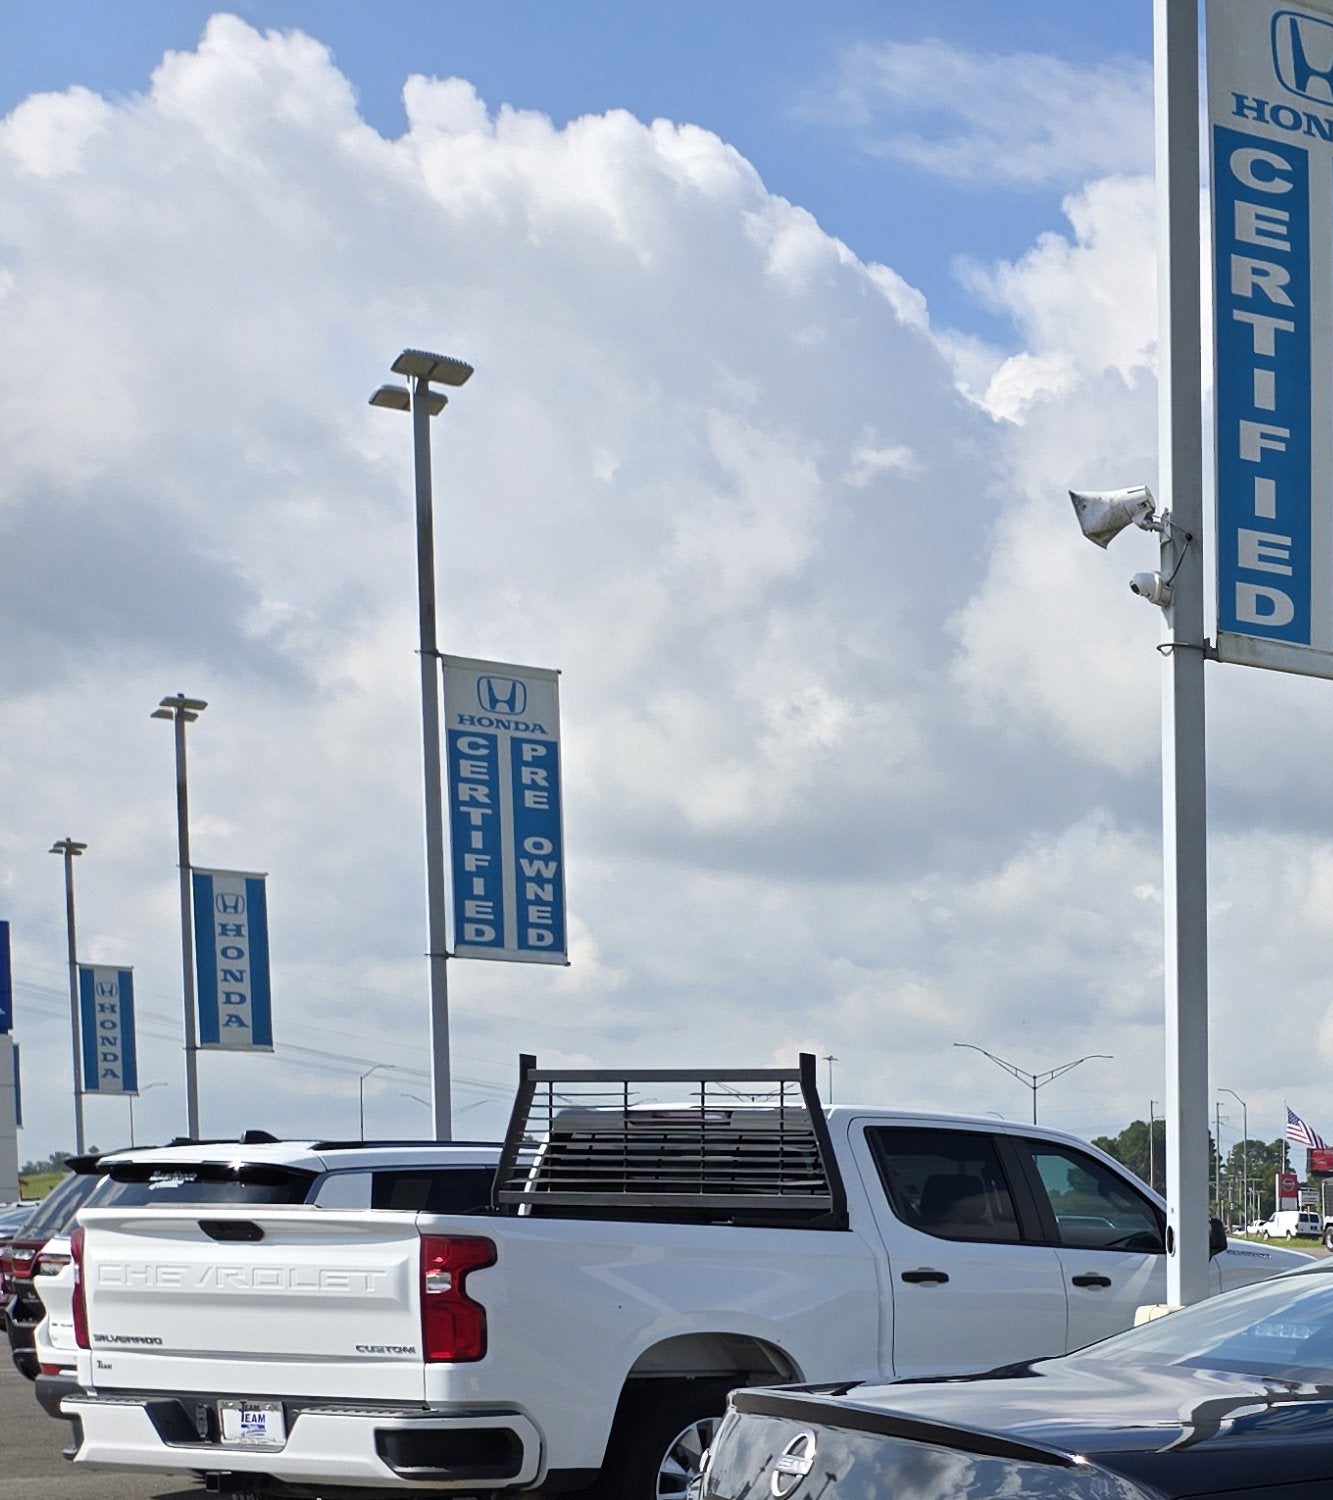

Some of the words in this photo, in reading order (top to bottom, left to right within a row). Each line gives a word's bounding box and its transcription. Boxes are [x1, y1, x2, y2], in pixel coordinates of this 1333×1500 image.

[1230, 148, 1296, 627] CERTIFIED
[457, 713, 548, 735] HONDA
[521, 742, 550, 810] PRE
[456, 736, 497, 943] CERTIFIED
[519, 836, 558, 947] OWNED
[217, 923, 250, 1029] HONDA
[98, 1002, 121, 1080] HONDA
[97, 1263, 388, 1293] CHEVROLET
[93, 1333, 164, 1346] SILVERADO
[355, 1344, 417, 1355] CUSTOM
[239, 1409, 266, 1423] TEAM
